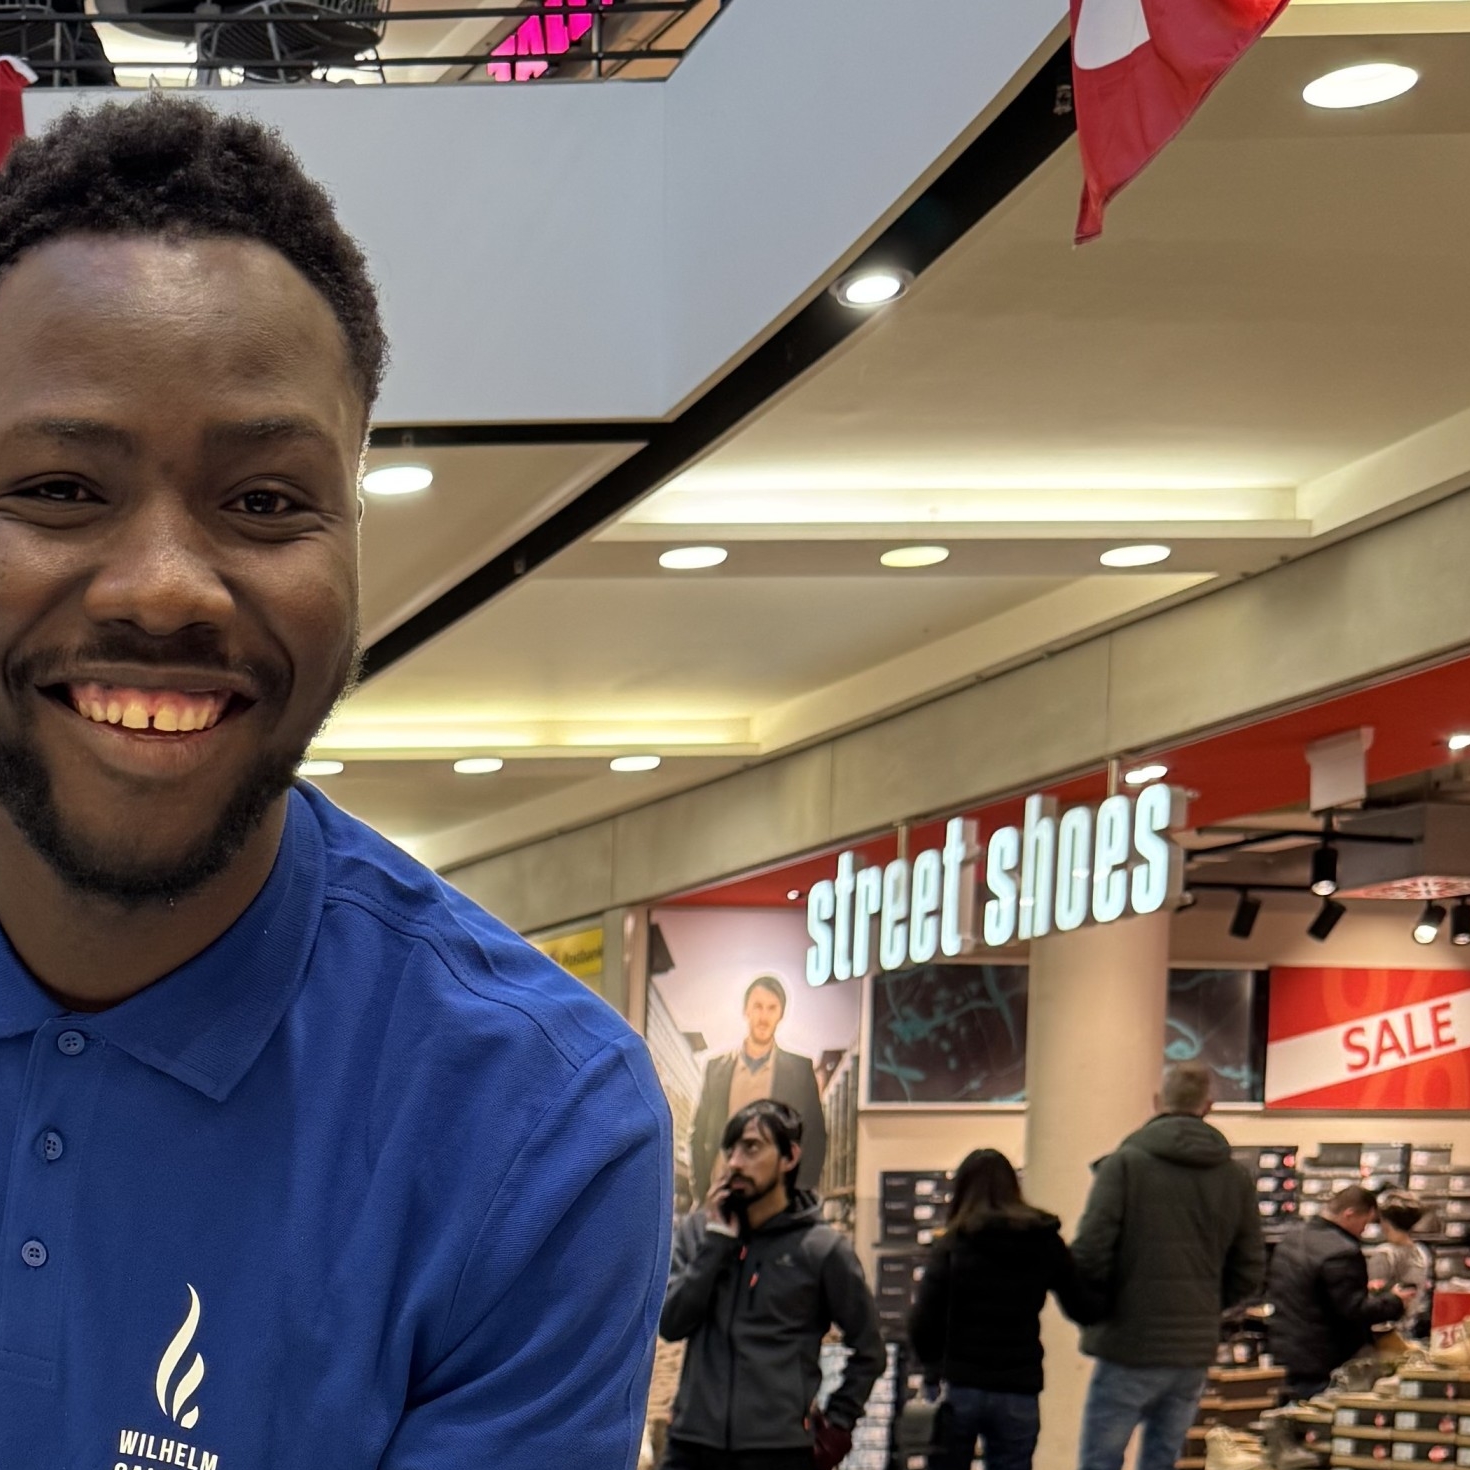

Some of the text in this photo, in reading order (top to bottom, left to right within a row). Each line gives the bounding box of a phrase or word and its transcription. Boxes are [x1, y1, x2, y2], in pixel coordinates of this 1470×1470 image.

[805, 783, 1171, 986] street shoes
[1342, 1002, 1456, 1073] SALE
